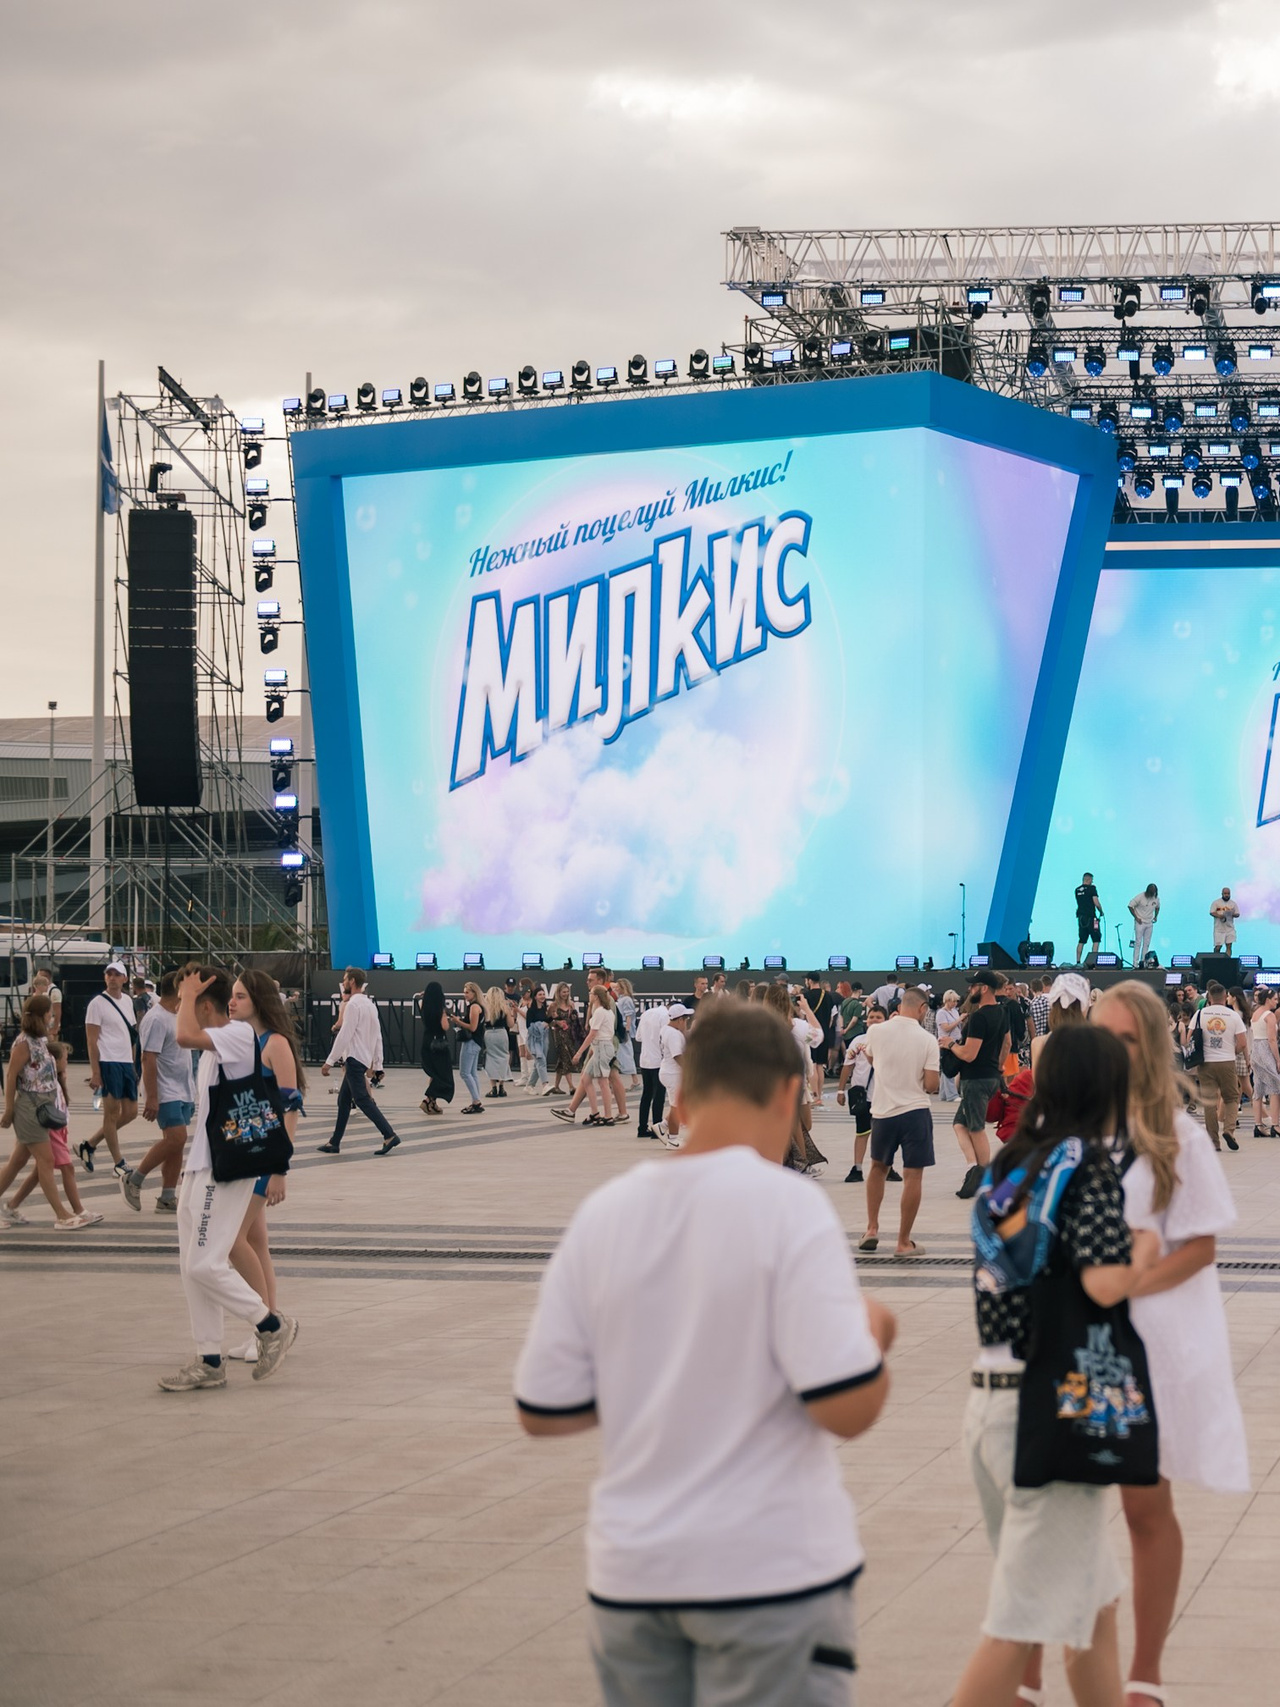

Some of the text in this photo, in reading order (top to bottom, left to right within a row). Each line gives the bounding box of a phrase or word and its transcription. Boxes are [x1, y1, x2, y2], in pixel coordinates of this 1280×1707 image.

[469, 450, 793, 577] Нежный поцелуй Милкис!
[233, 1089, 257, 1107] VK
[197, 1185, 216, 1247] Palm Angels
